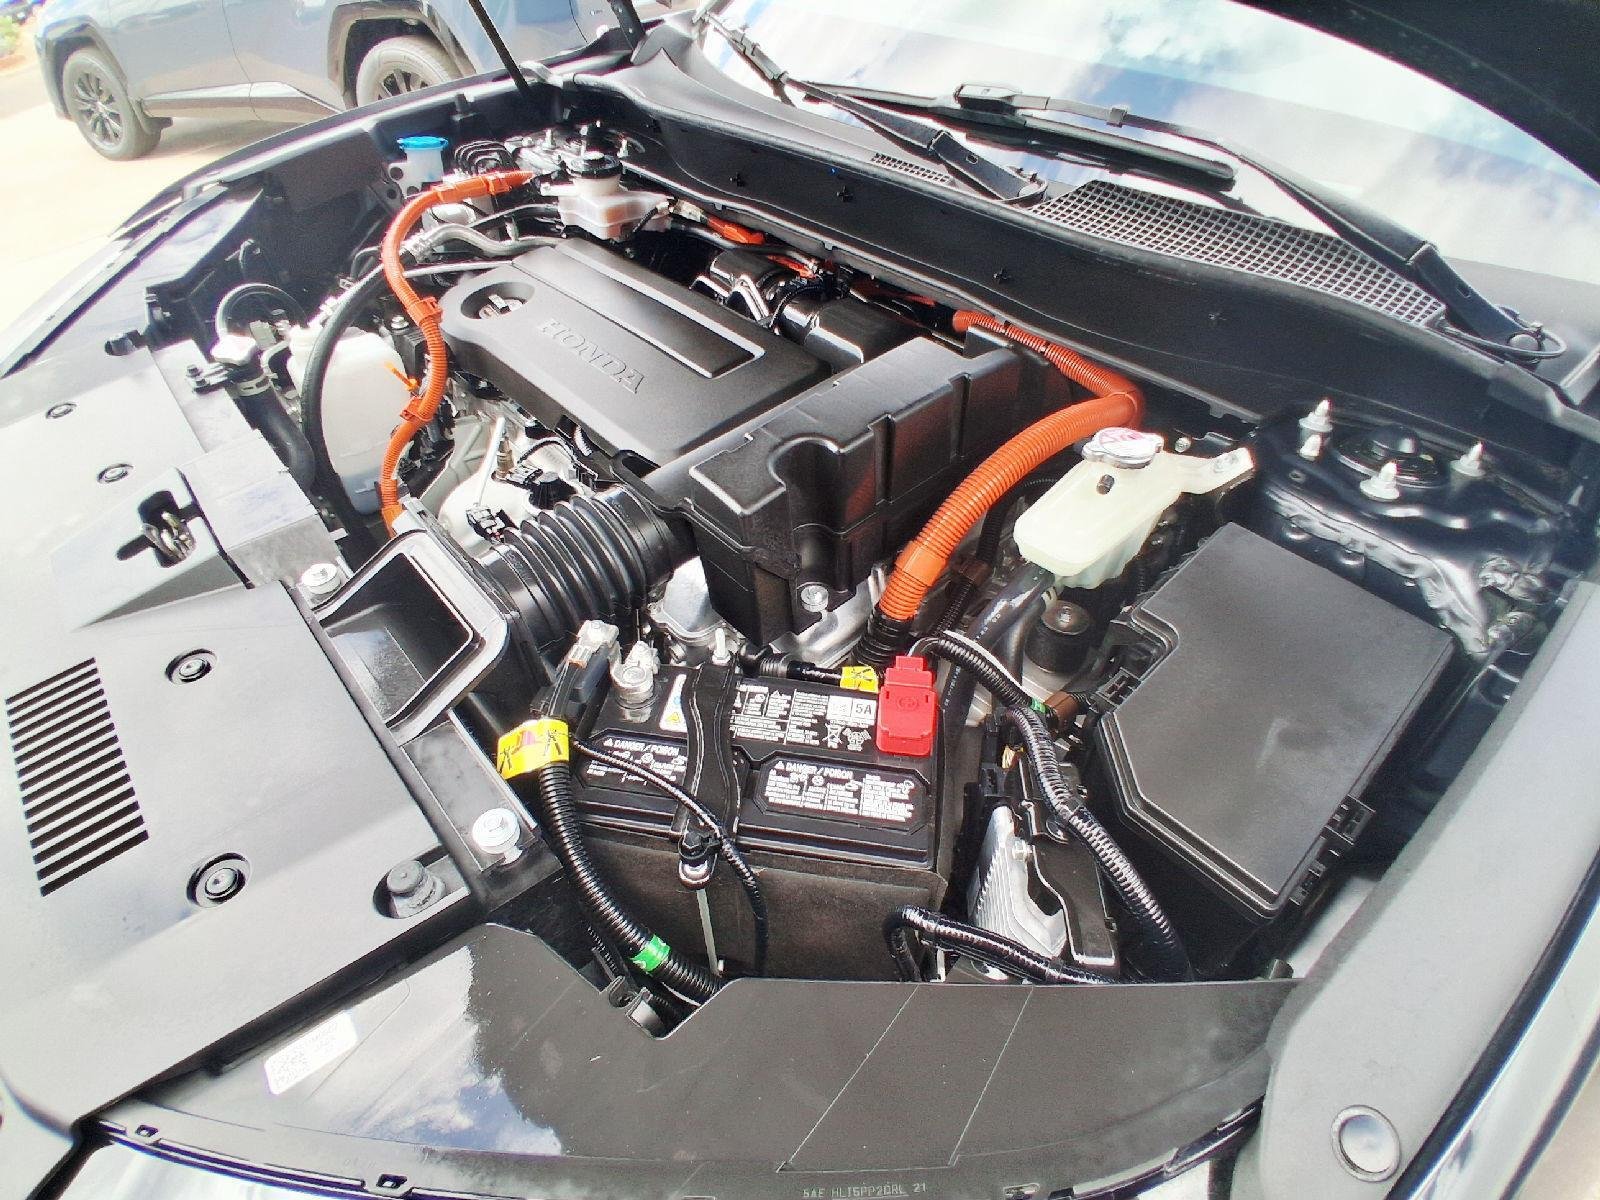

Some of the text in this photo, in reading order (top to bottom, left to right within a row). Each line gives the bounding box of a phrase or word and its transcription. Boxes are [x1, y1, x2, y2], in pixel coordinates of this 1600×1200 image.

[540, 320, 645, 395] HONDA
[855, 703, 873, 715] 5A
[613, 740, 645, 752] DANGER
[650, 745, 680, 757] POISON
[785, 762, 817, 775] DANGER
[823, 766, 854, 780] POISON
[912, 1182, 927, 1193] 21
